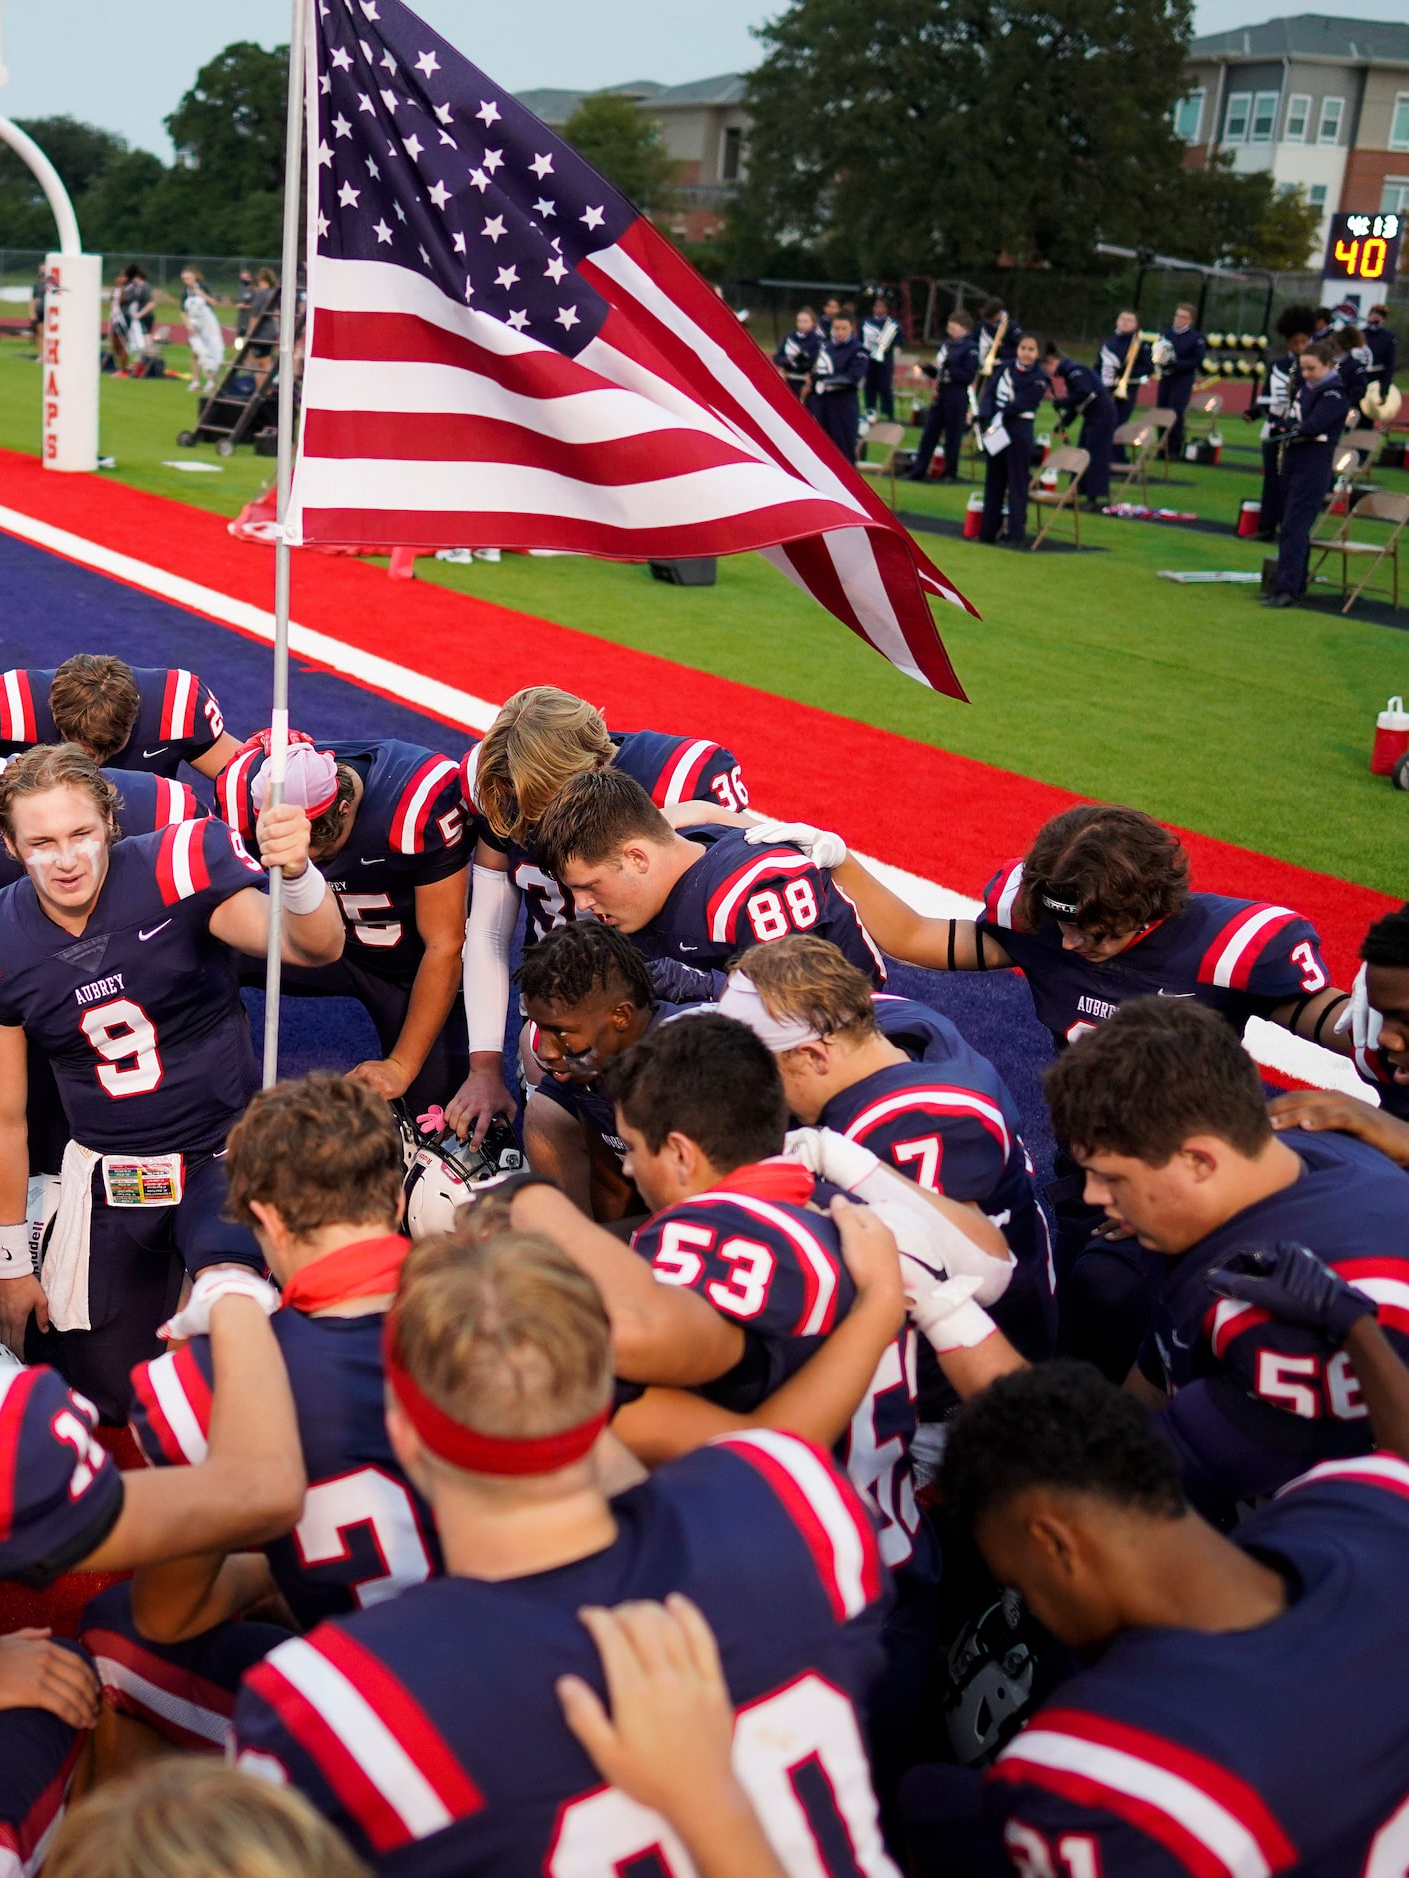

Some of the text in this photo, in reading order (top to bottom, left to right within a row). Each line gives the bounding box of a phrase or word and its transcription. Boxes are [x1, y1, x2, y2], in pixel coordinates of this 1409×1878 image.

[1334, 238, 1388, 278] 40
[43, 306, 60, 460] CHAPS
[203, 688, 225, 741] 2
[709, 764, 749, 814] 36
[746, 875, 820, 944] 88
[74, 973, 126, 1005] AUBREY
[1289, 939, 1328, 995] 3
[1077, 995, 1120, 1020] AUBRE
[78, 995, 166, 1100] 9
[891, 1132, 945, 1196] 7
[651, 1218, 779, 1322] 53
